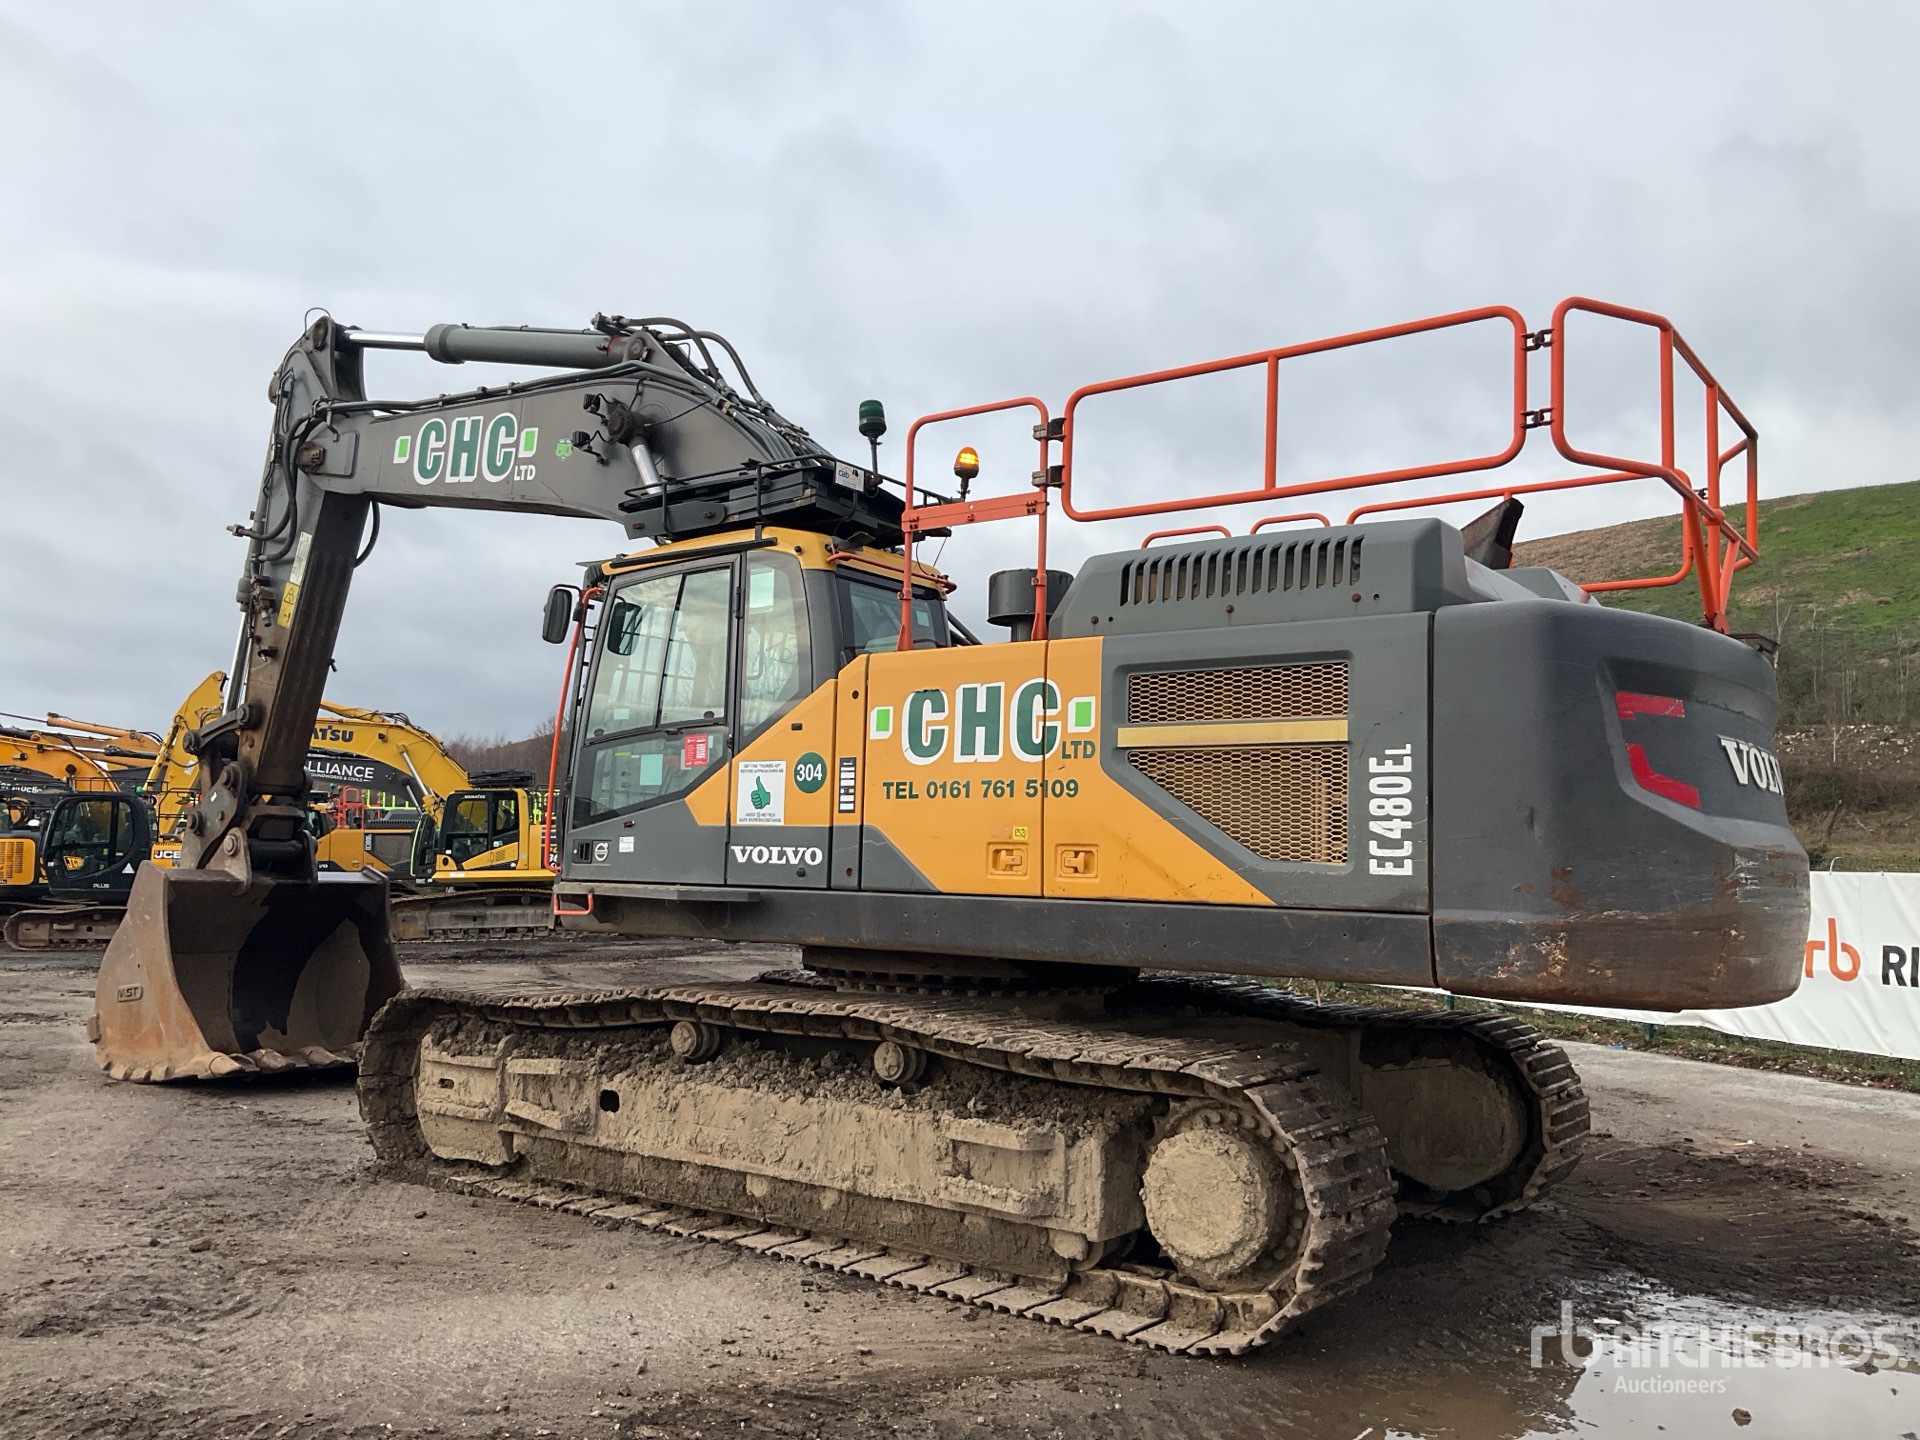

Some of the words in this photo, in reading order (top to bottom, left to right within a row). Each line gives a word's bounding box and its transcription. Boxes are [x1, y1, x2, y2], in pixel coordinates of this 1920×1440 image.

[413, 412, 518, 485] CHC
[514, 465, 536, 481] LTD
[901, 677, 1062, 766] CHC
[1061, 740, 1096, 759] LTD
[796, 763, 822, 781] 304
[883, 781, 919, 800] TEL
[926, 780, 971, 799] 0161
[981, 779, 1015, 798] 761
[1025, 778, 1079, 798] 5109
[1369, 743, 1413, 876] EC480EL
[731, 846, 823, 866] VOLVO
[1805, 917, 1861, 982] rb
[1882, 945, 1920, 988] RI
